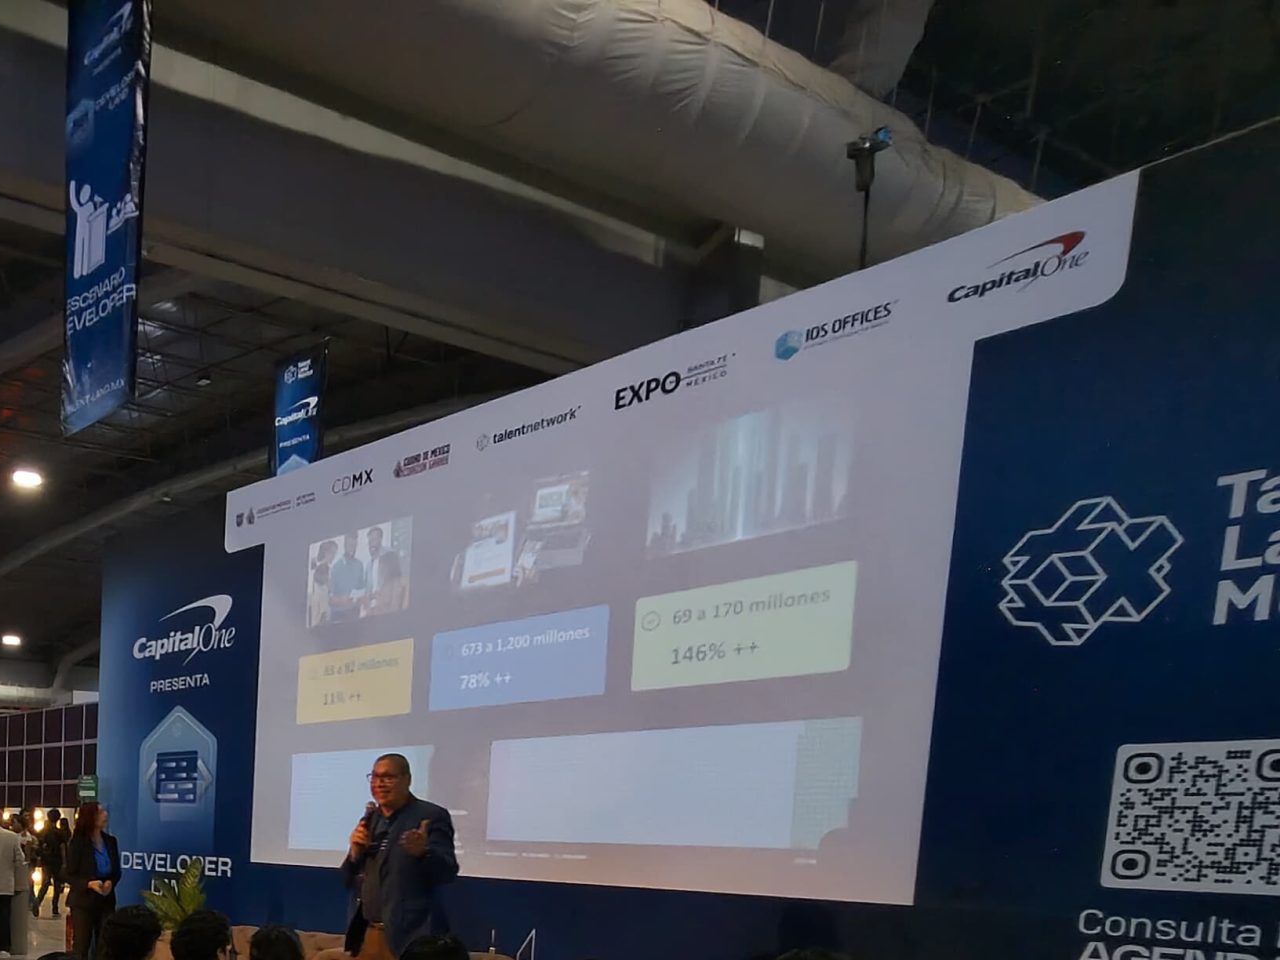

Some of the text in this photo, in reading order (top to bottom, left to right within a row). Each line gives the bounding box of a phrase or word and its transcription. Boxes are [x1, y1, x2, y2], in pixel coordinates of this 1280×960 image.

[67, 283, 136, 335] EVELOPER
[832, 302, 892, 334] OFFICES
[614, 371, 681, 410] EXPO
[331, 468, 373, 494] CDMX
[673, 589, 831, 625] 69 a 170 millones
[1213, 575, 1280, 625] M
[462, 627, 590, 657] 673 a 1,200 millones
[671, 641, 726, 664] 146%
[150, 674, 210, 693] PRESENTA
[459, 672, 490, 690] 78%
[1078, 909, 1262, 947] Consulta
